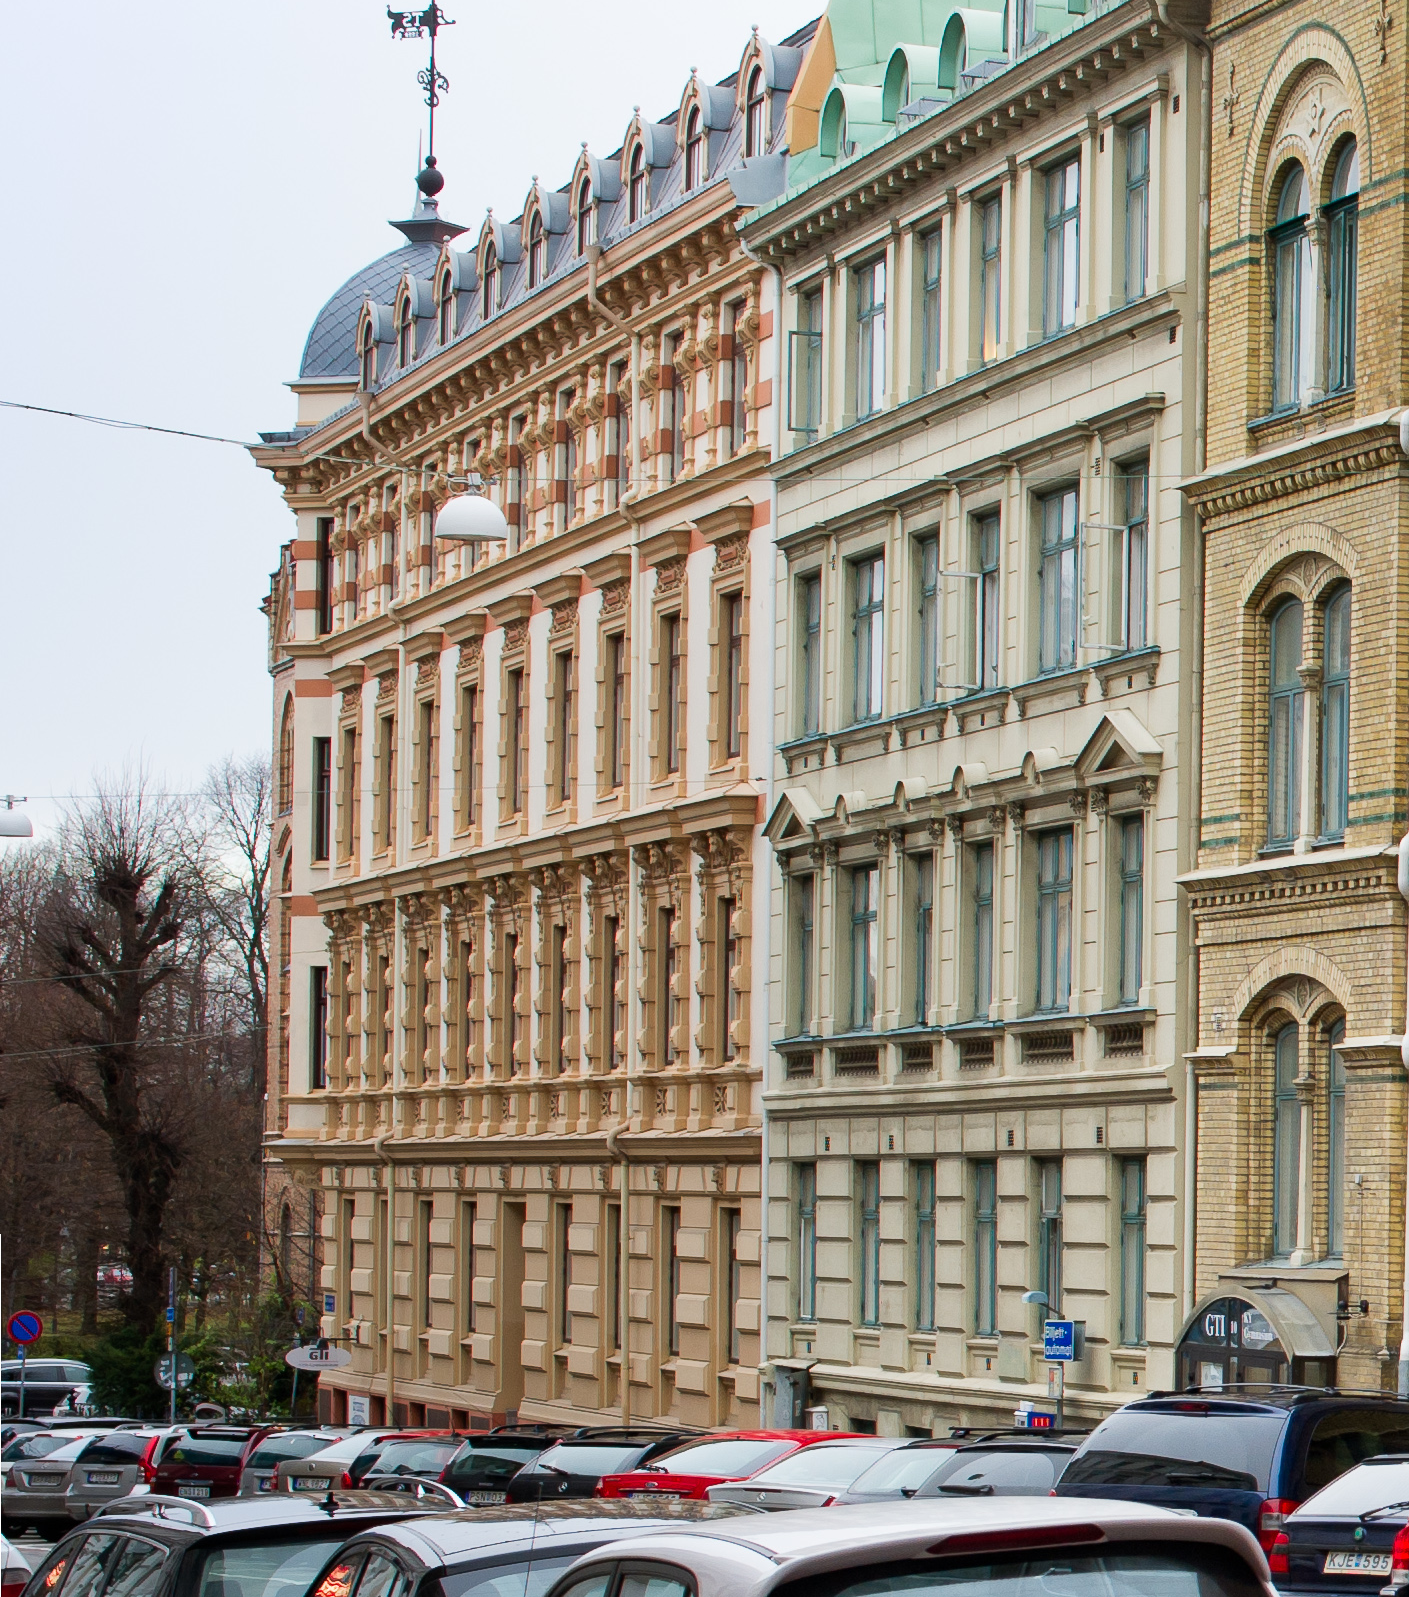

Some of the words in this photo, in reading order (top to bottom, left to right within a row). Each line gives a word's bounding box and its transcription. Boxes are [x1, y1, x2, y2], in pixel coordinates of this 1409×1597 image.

[1205, 1314, 1226, 1336] GTI
[489, 1491, 506, 1503] 03
[1328, 1553, 1354, 1568] KJE
[1362, 1554, 1390, 1569] 595
